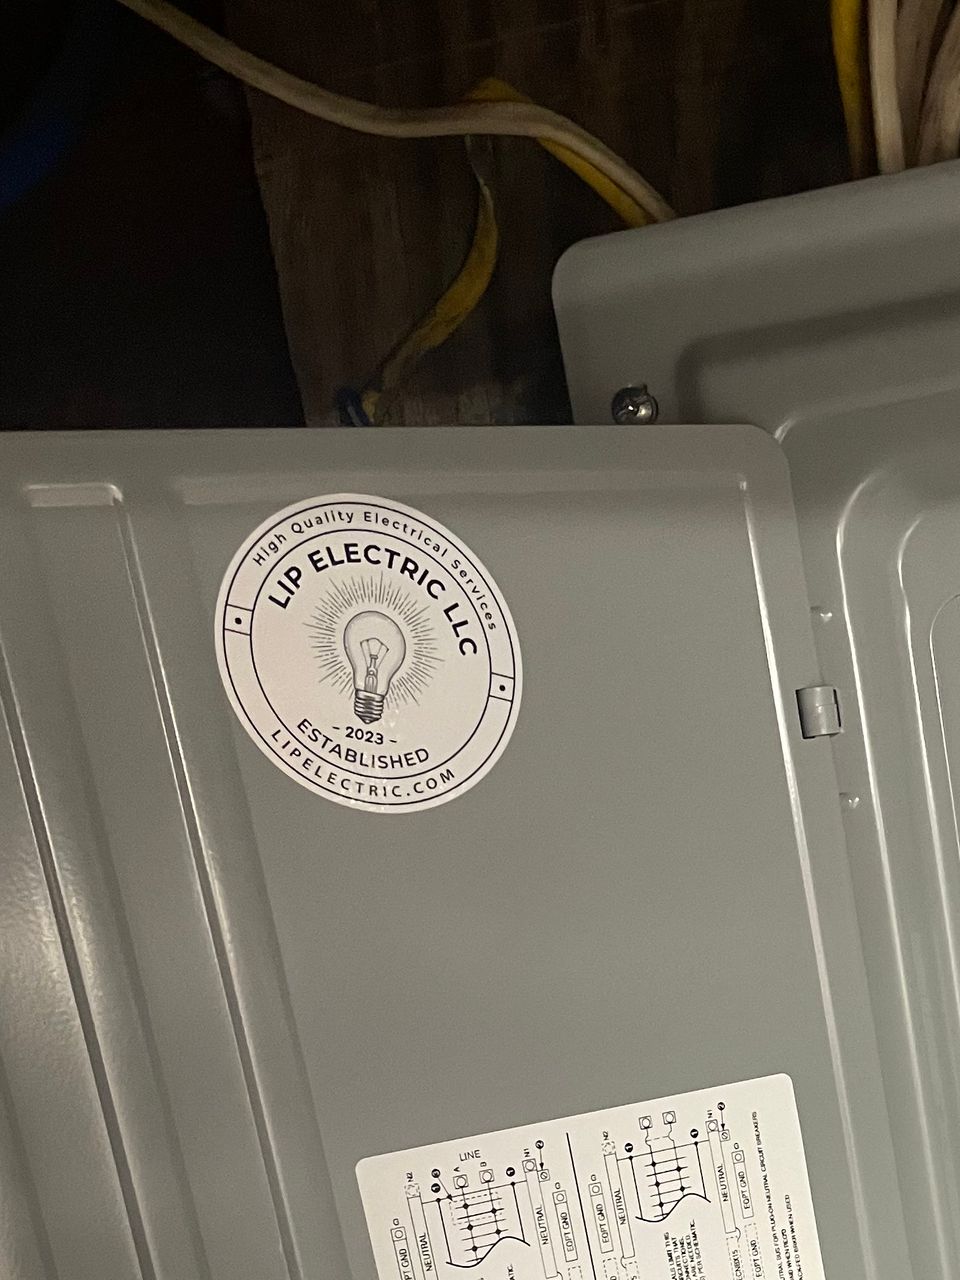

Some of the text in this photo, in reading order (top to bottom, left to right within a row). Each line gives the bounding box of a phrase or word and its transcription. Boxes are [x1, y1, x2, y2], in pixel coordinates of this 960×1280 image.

[253, 511, 496, 631] High Quality Electrical Services
[268, 543, 477, 656] LIP ELECTRIC LLC
[297, 718, 430, 769] ESTABLISHED
[345, 726, 384, 745] 2023
[271, 729, 455, 797] LIPELECTRIC.COM
[458, 1148, 482, 1162] LINE
[716, 1163, 729, 1202] NEUTRAL
[737, 1169, 750, 1209] EQPT GND
[534, 1204, 549, 1245] NEUTRAL
[595, 1202, 610, 1243] EQPT GND
[612, 1187, 627, 1225] NEUTRAL
[418, 1231, 433, 1272] NEUTRAL
[559, 1211, 574, 1252] EQPT GND
[398, 1247, 410, 1268] GND
[749, 1238, 762, 1277] EQPT GND
